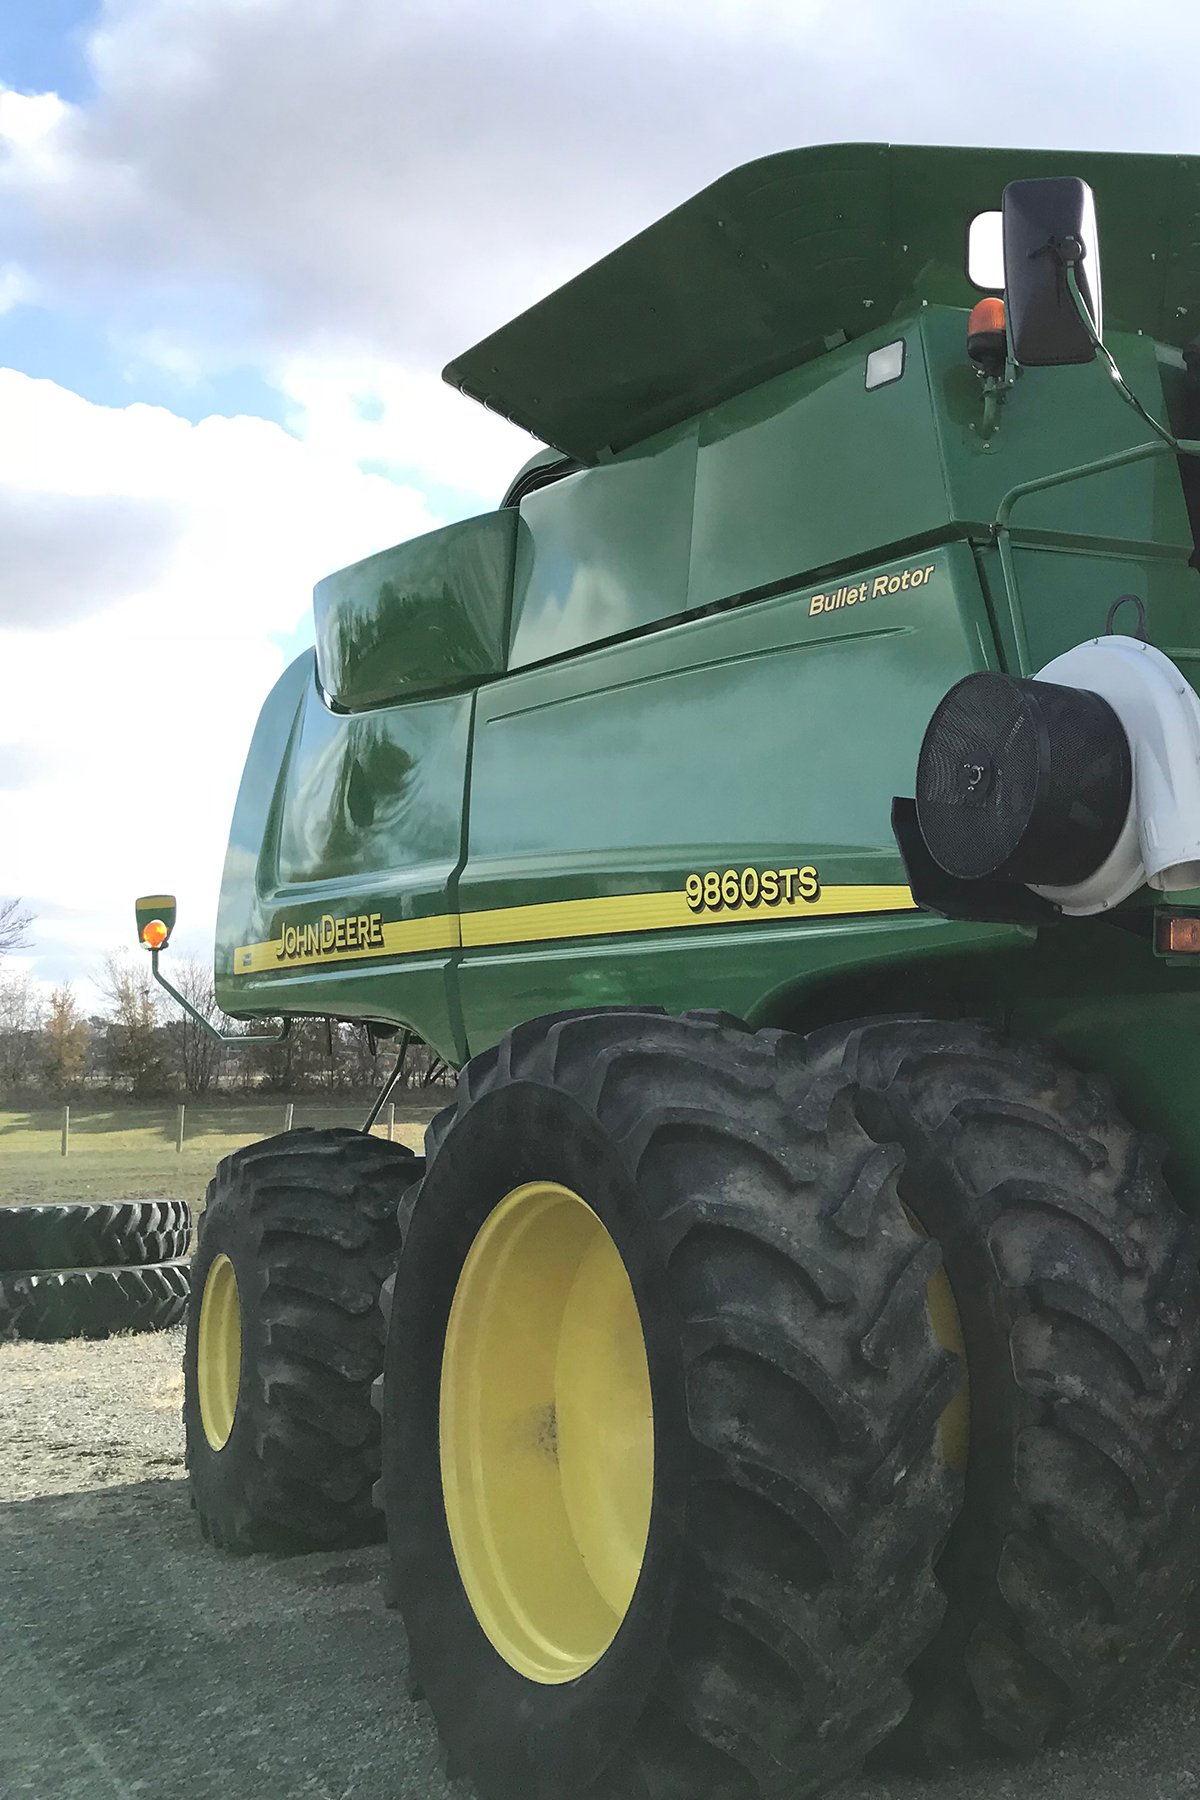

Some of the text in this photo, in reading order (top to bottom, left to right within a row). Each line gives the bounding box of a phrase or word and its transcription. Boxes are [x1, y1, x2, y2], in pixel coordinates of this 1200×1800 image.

[809, 565, 935, 617] Bullet Rotor
[685, 865, 820, 912] 9860STS
[321, 913, 384, 952] DEERE
